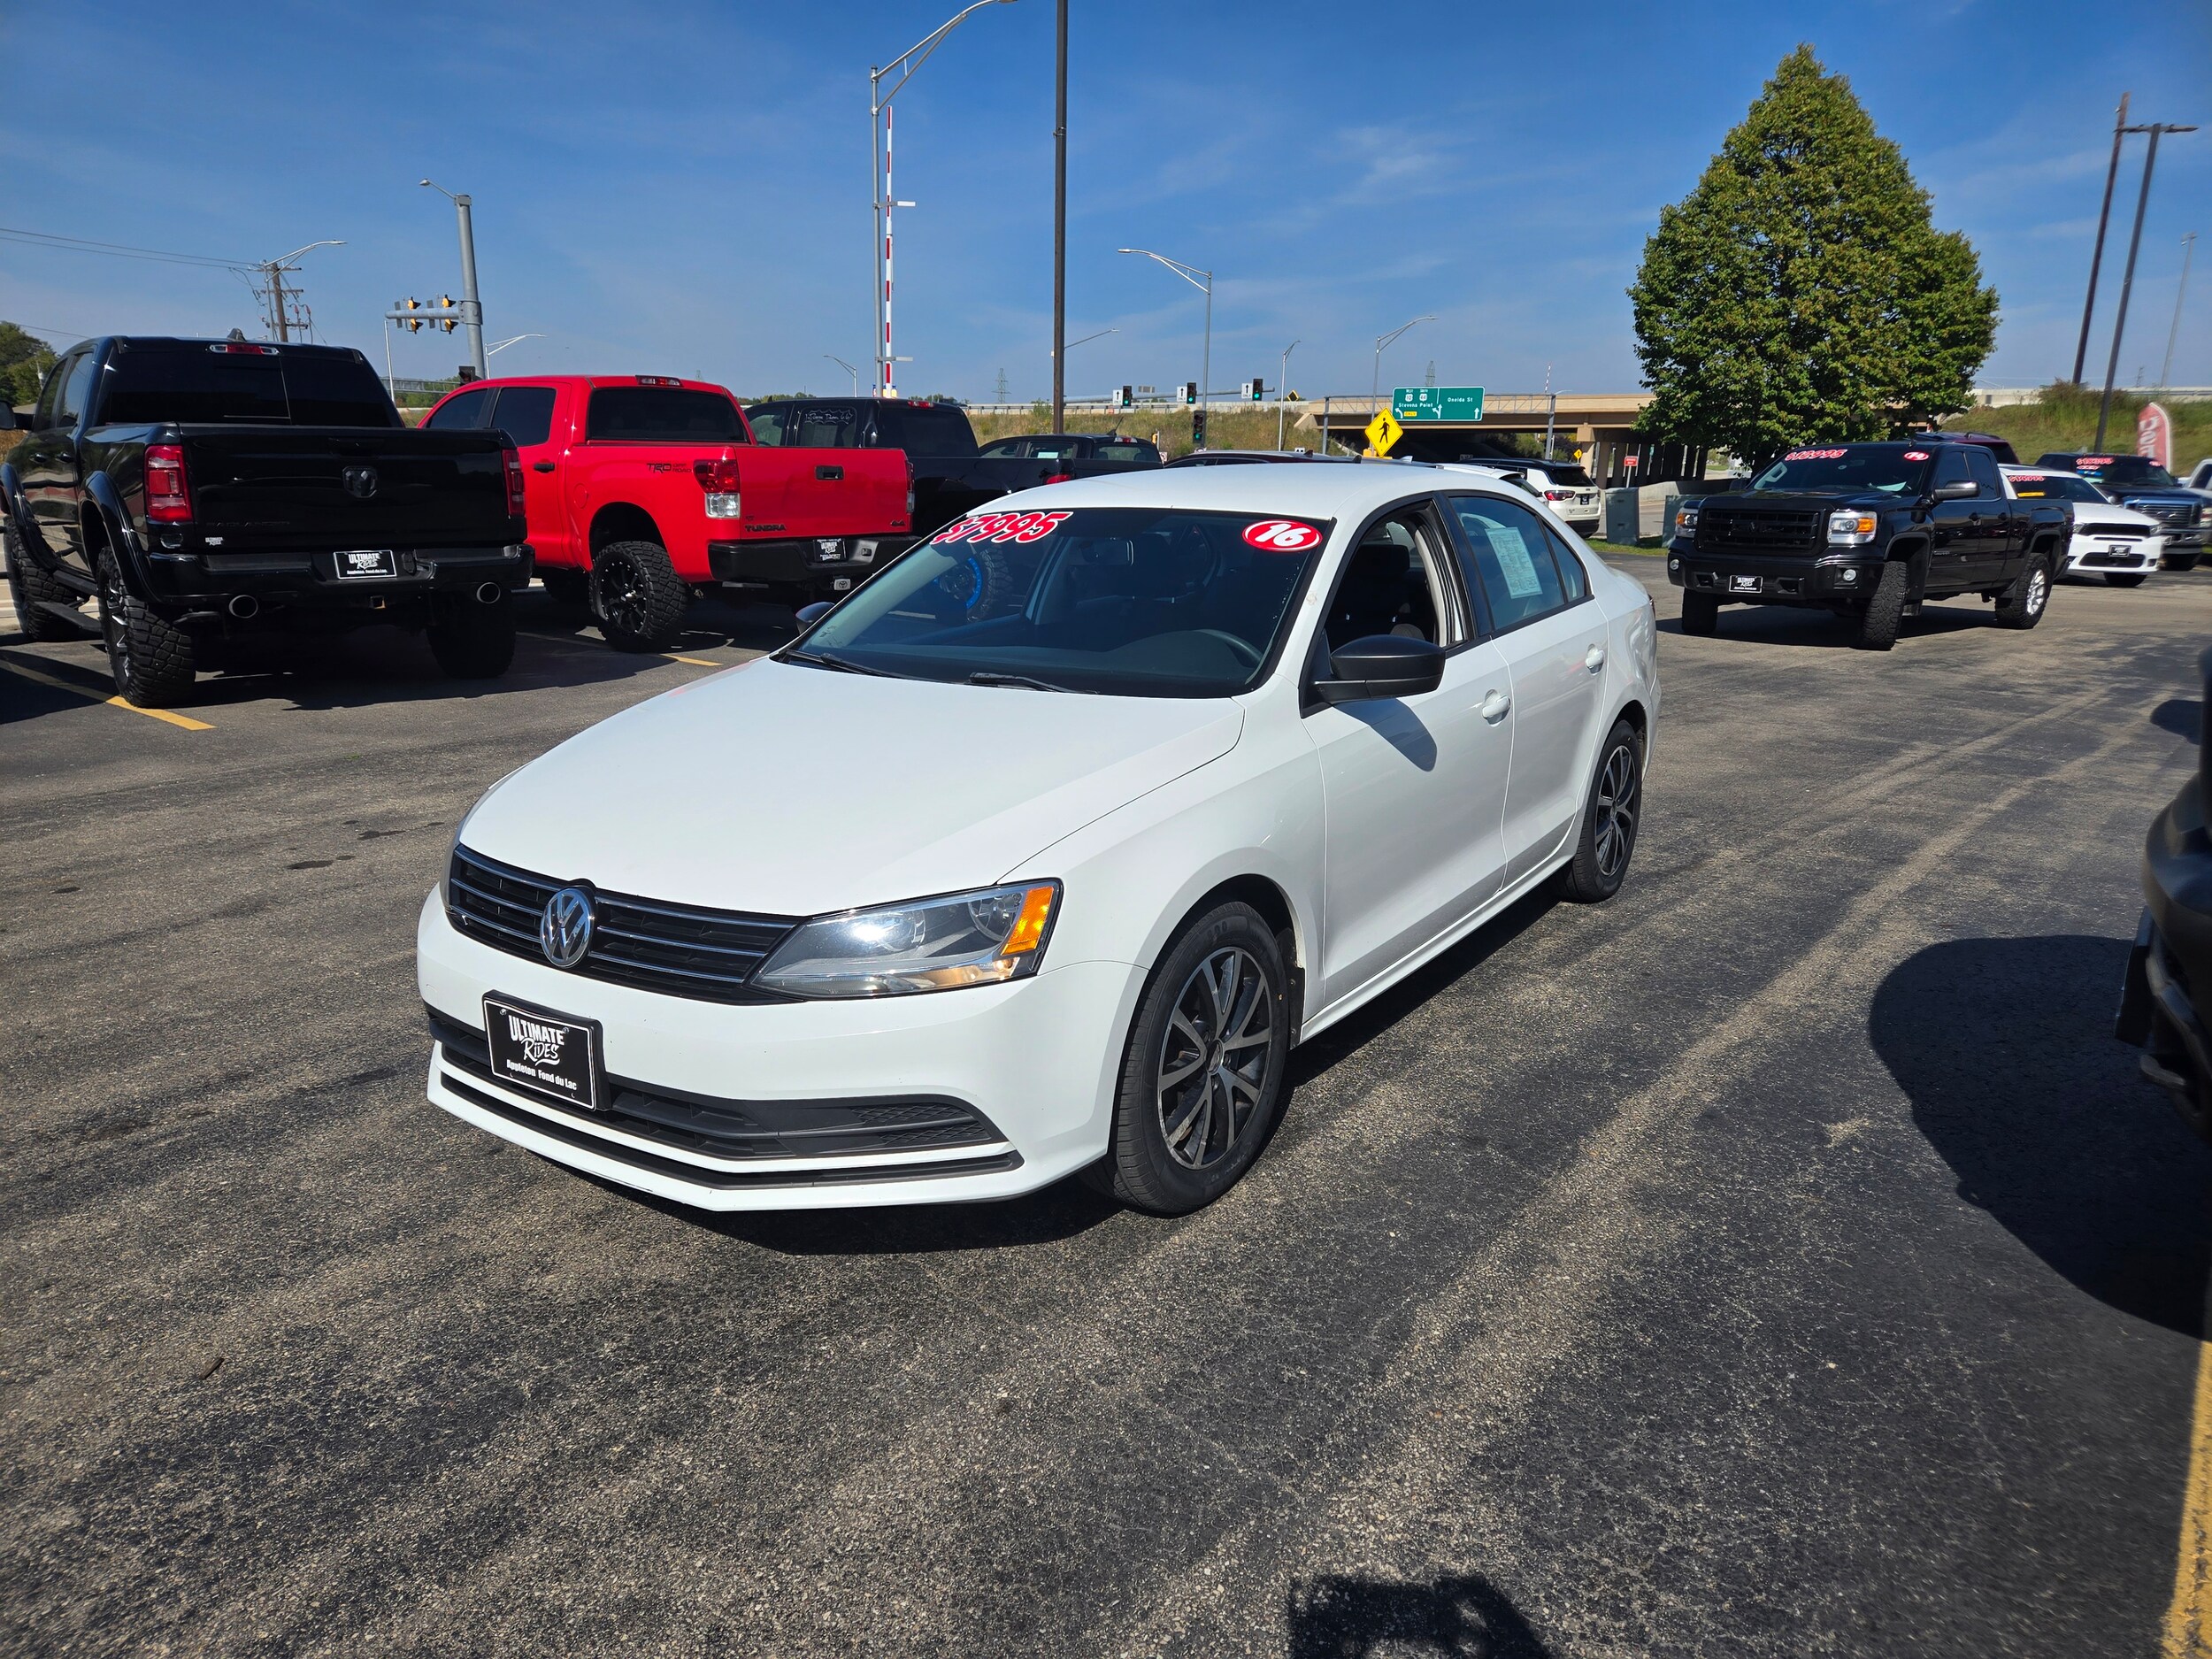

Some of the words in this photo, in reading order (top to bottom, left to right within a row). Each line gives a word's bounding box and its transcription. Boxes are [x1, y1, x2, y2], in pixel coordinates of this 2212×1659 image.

[647, 463, 672, 473] TRD
[1255, 523, 1312, 547] 16
[348, 552, 381, 564] ULTIMATE
[509, 1015, 565, 1045] ULTIMATE
[506, 1059, 536, 1077] Appleton
[538, 1069, 556, 1085] Fond
[555, 1075, 565, 1087] du
[565, 1079, 577, 1090] Lac
